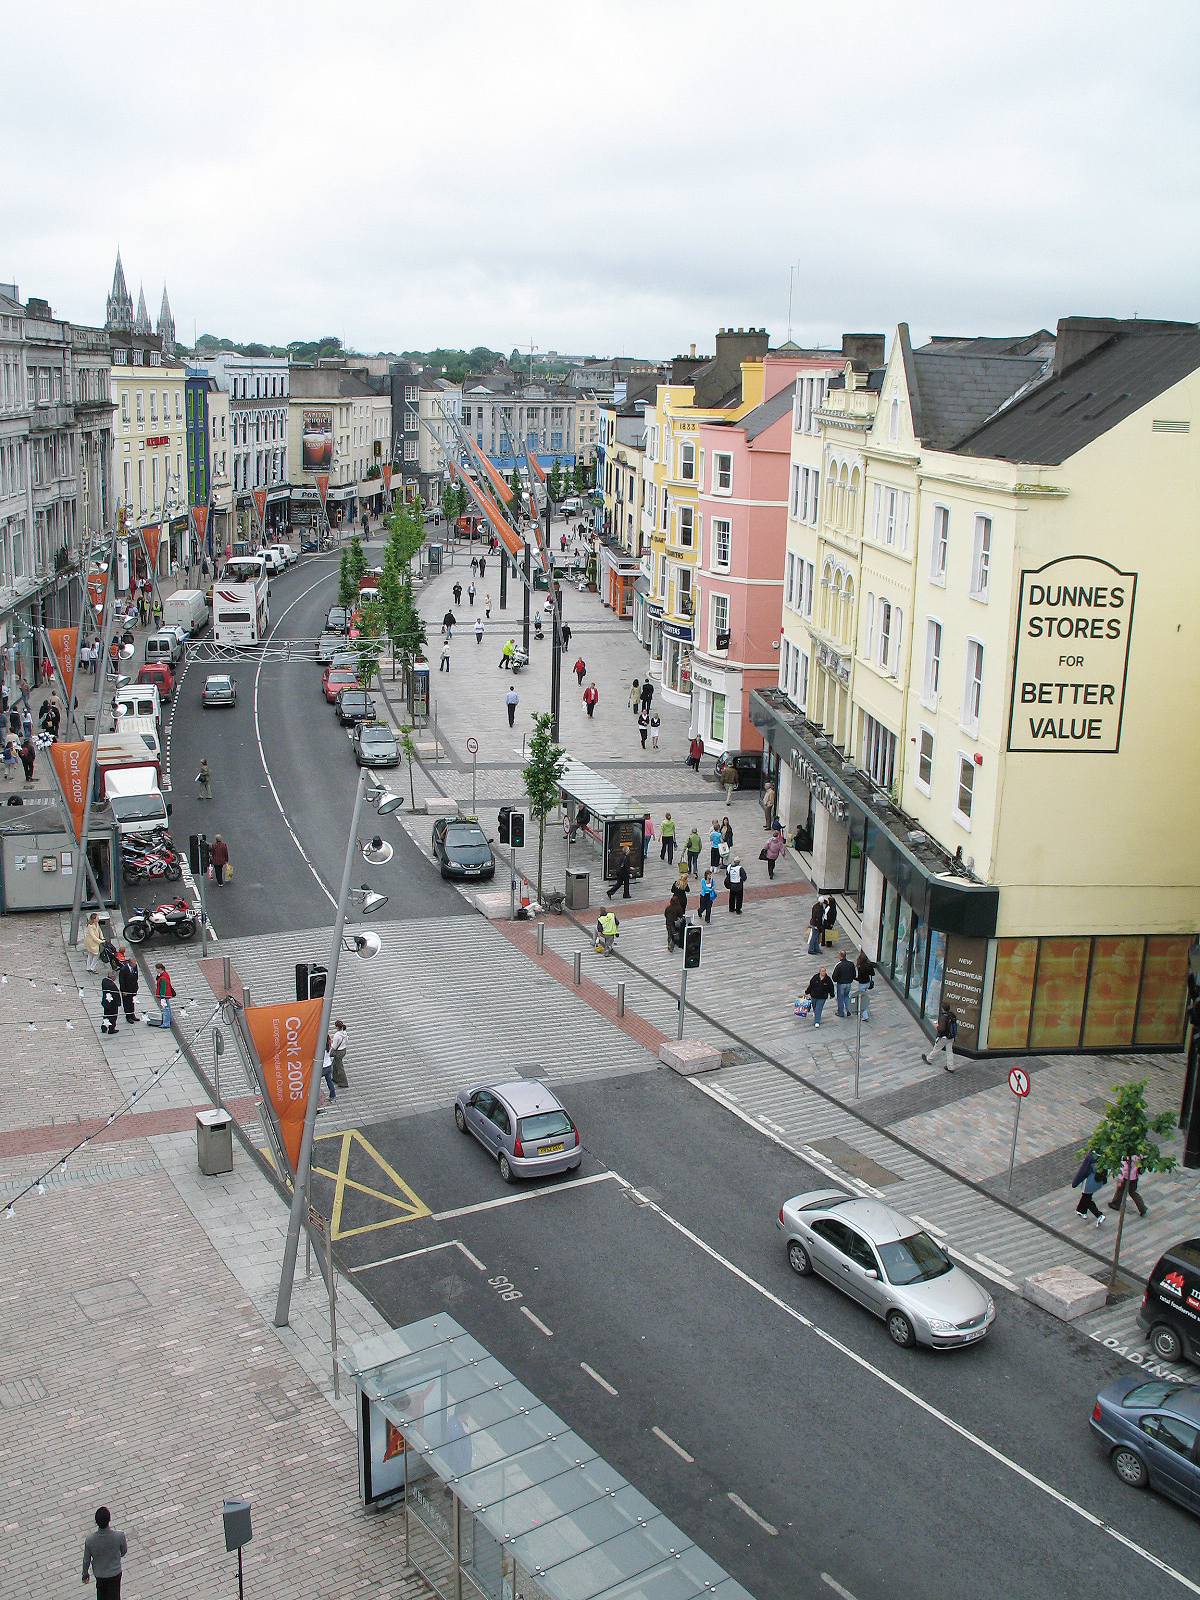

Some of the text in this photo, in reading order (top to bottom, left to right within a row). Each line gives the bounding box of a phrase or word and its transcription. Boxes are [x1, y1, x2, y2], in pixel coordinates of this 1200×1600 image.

[679, 422, 696, 430] 1833
[301, 491, 335, 499] PORR
[1029, 584, 1125, 608] DUNNES
[1027, 616, 1121, 640] STORES
[63, 634, 72, 673] Cork 2005
[1058, 655, 1085, 667] FOR
[1020, 682, 1116, 706] BETTER
[1029, 717, 1103, 740] VALUE
[69, 750, 82, 803] Cork 2005
[958, 957, 973, 966] NEW
[945, 966, 983, 982] LADIESWEAR
[944, 979, 982, 994] DEPARTMENT
[946, 992, 978, 1005] NOW OPEN
[956, 1007, 966, 1015] ON
[285, 1016, 304, 1101] Cork 2005
[488, 1275, 524, 1301] BUS
[1160, 1294, 1172, 1306] total
[1170, 1300, 1197, 1321] foodservice
